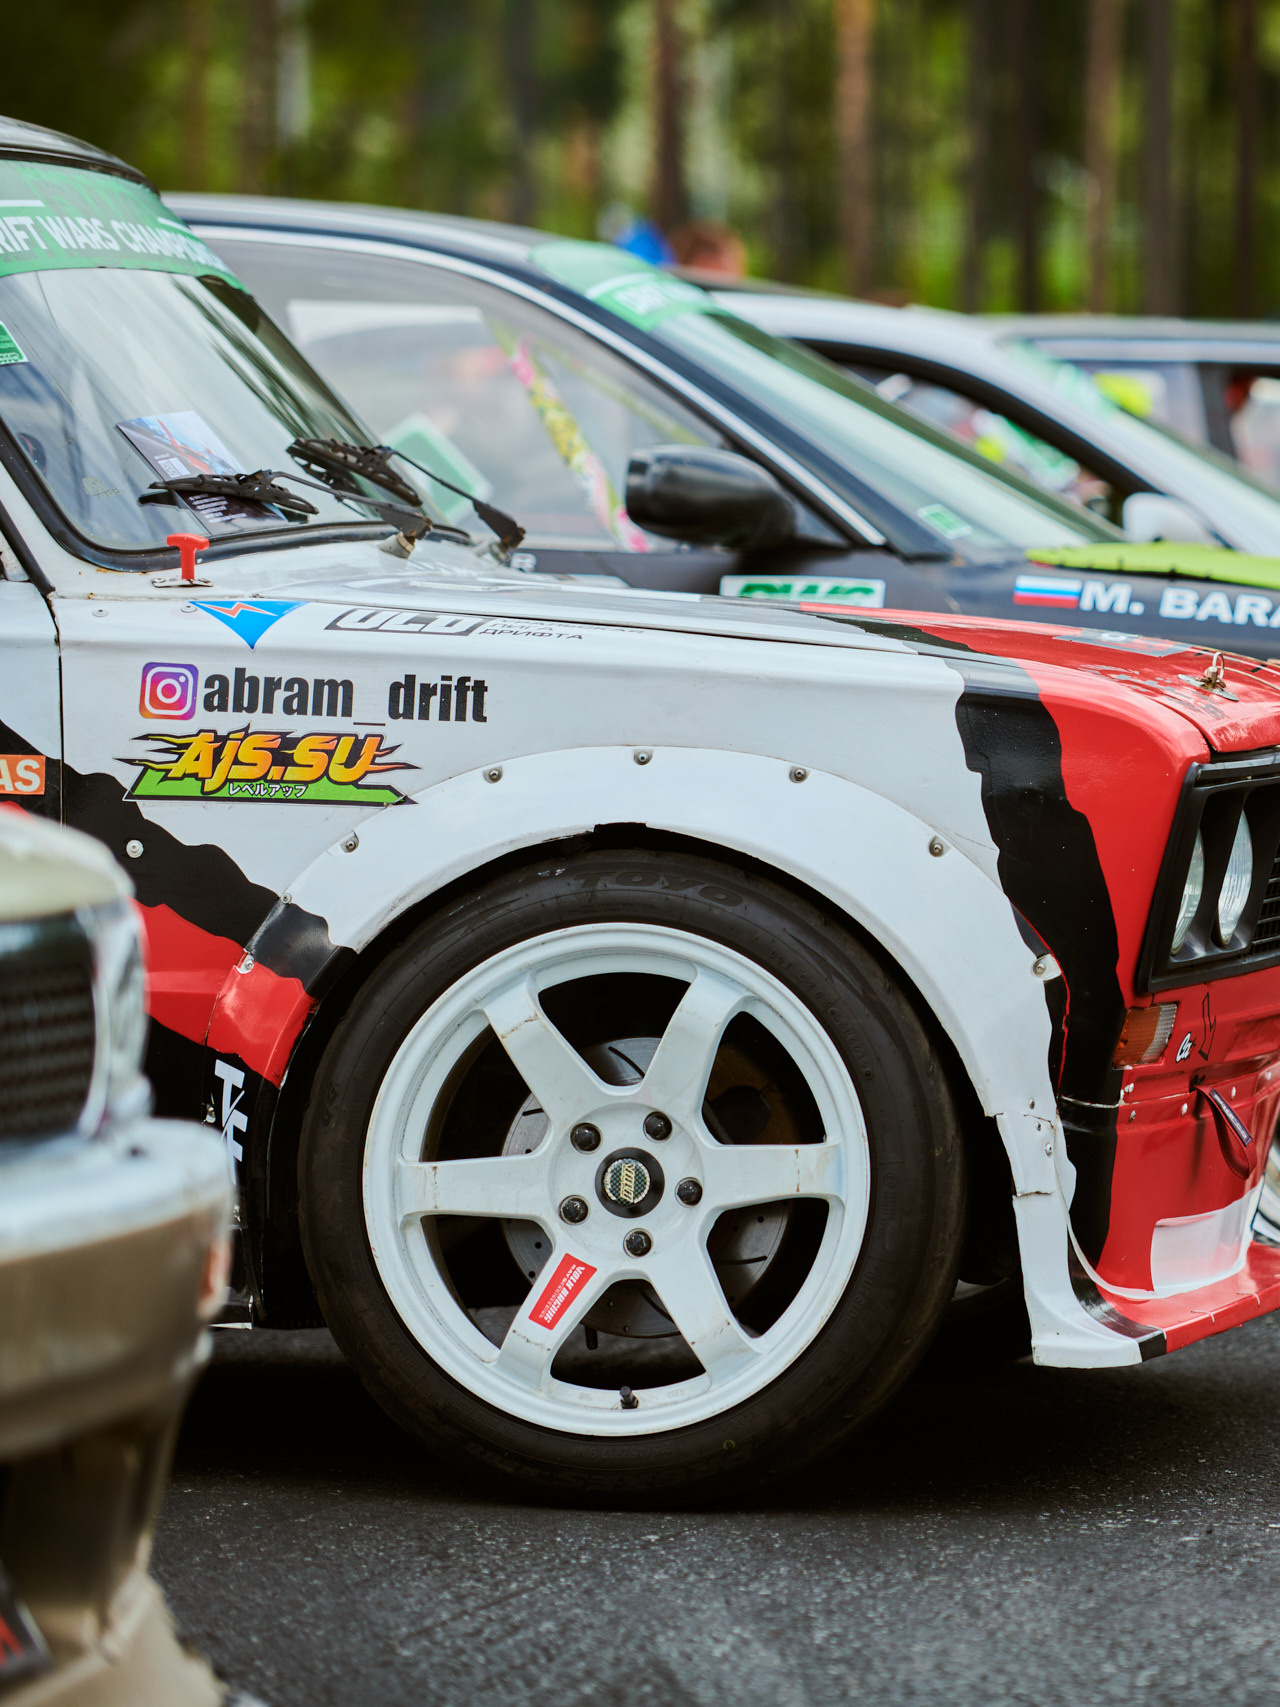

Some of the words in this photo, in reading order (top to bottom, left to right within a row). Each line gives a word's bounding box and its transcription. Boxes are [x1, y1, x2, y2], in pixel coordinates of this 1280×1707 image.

[35, 215, 120, 251] WARS
[1079, 581, 1145, 615] M.
[478, 628, 584, 640] ДРИФТА
[203, 667, 488, 726] abram_drift
